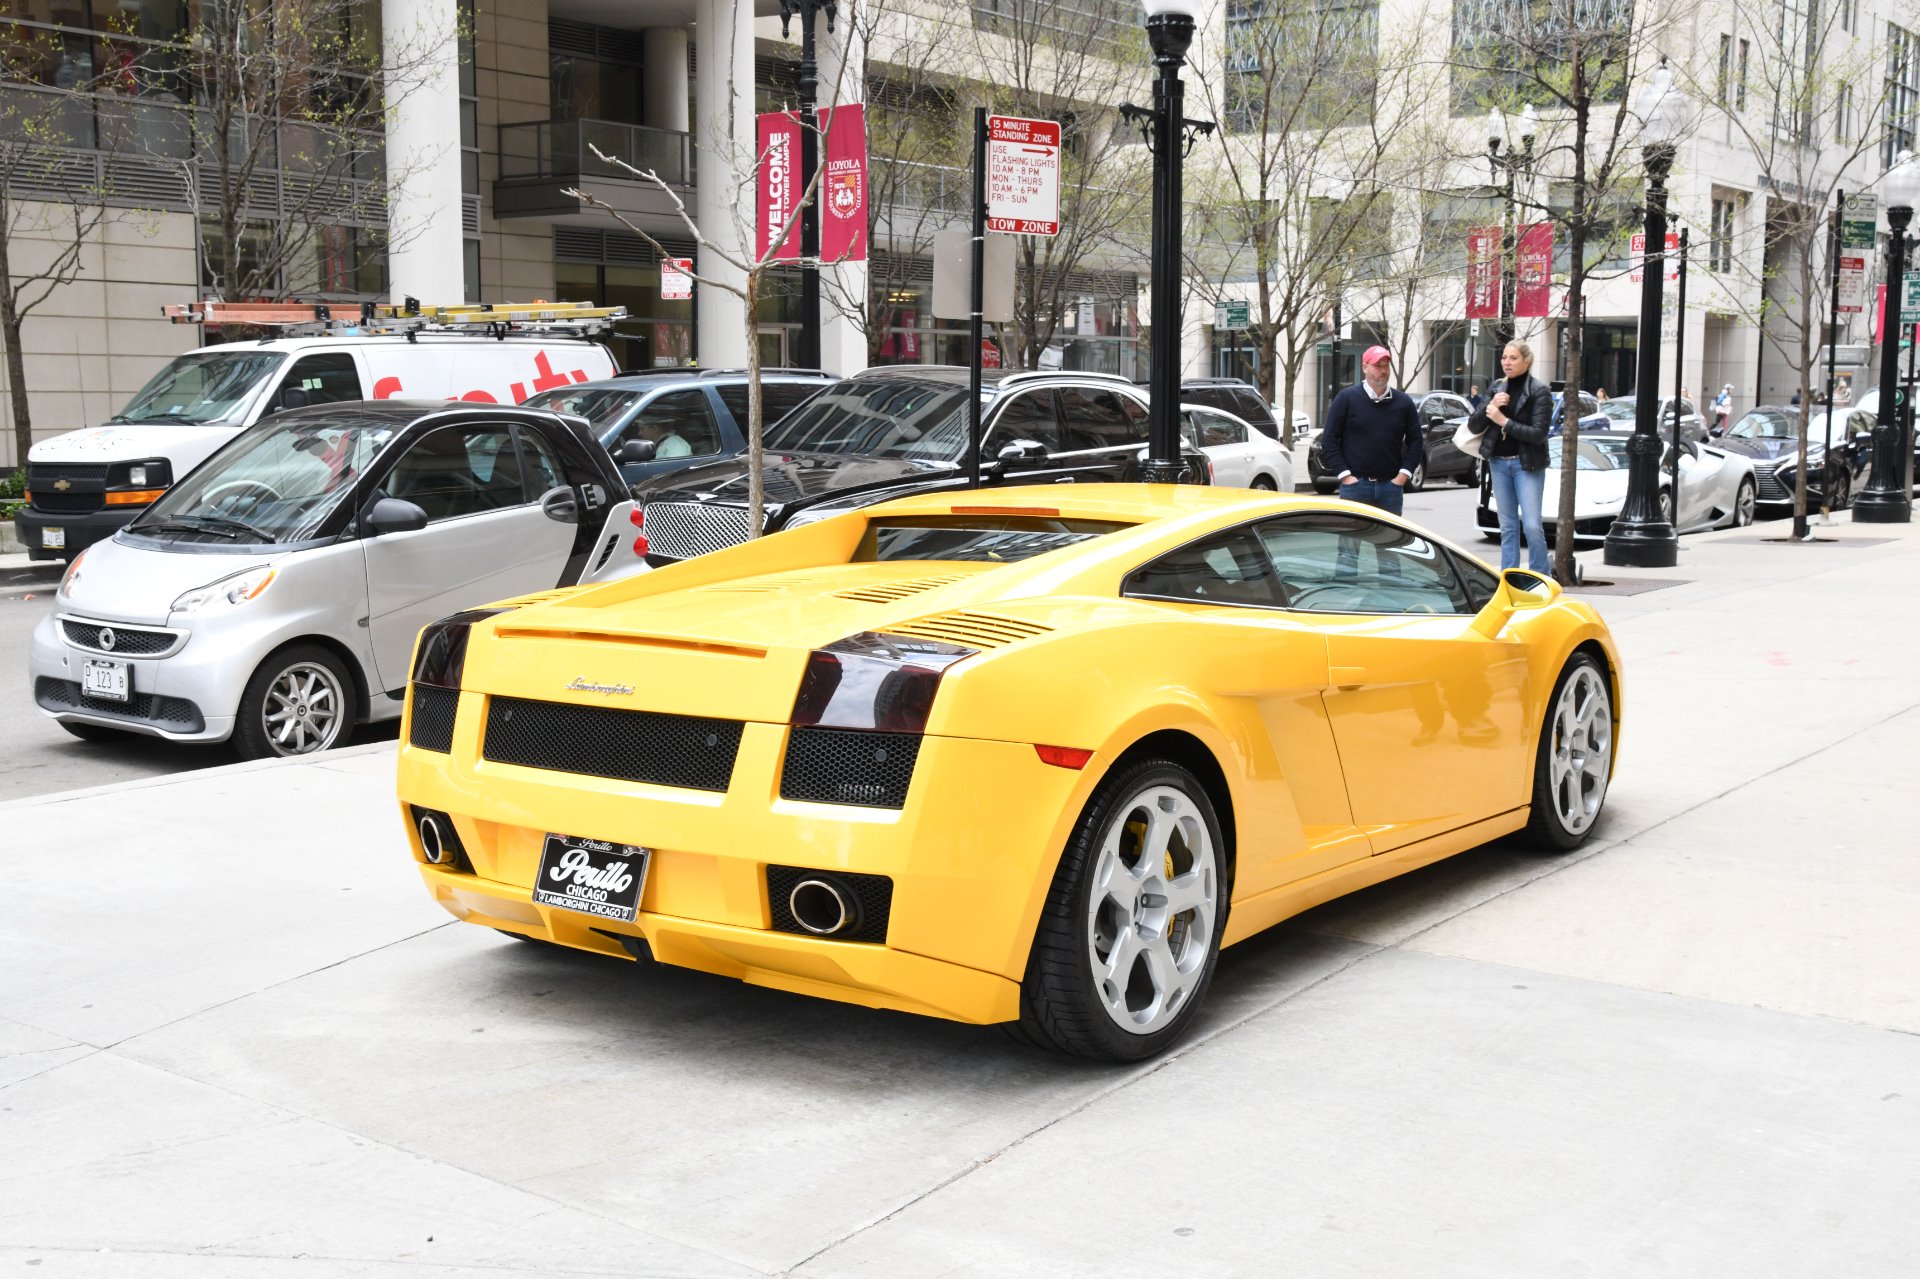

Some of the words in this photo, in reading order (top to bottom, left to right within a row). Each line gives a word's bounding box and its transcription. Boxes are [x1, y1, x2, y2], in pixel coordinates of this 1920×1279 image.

[993, 120, 1001, 129] 15
[1003, 121, 1031, 132] MINUTE
[993, 129, 1029, 141] STANDING
[1032, 134, 1053, 144] ZONE
[783, 132, 791, 174] CAMPUS
[992, 145, 1008, 154] USE
[828, 159, 861, 171] LOYOLA
[992, 154, 1029, 166] FLASHING
[1030, 158, 1056, 169] LIGHTS
[1021, 166, 1026, 175] 8
[1028, 167, 1040, 176] PM
[992, 174, 1009, 183] MON
[1017, 176, 1043, 186] THURS
[768, 132, 783, 246] WELCOME
[783, 175, 791, 211] TOWER
[1020, 186, 1026, 195] 6
[1027, 187, 1039, 196] PM
[991, 193, 1005, 202] FRI
[1012, 194, 1028, 204] SUN
[991, 218, 1016, 231] TOW
[1022, 220, 1052, 234] ZONE
[97, 671, 111, 689] 123
[565, 677, 636, 696] Lamborghini
[579, 838, 613, 851] Perillo
[550, 849, 633, 893] Perillo
[566, 884, 608, 902] CHICAGO
[544, 894, 589, 911] LAMBORGHINI
[589, 903, 621, 918] CHICAGO
